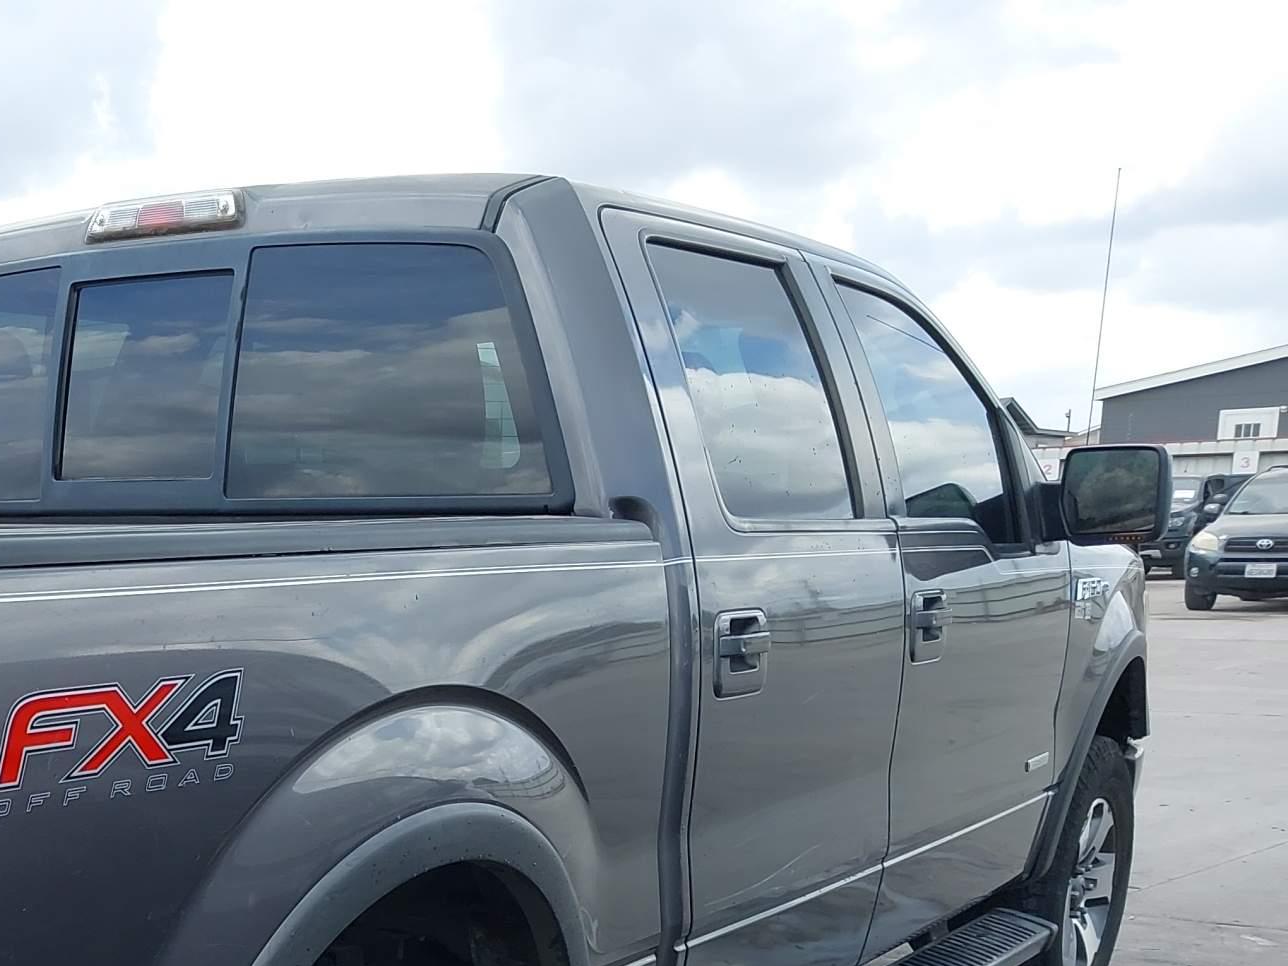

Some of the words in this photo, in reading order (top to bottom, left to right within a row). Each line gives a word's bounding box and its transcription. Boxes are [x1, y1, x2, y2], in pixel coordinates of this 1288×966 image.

[1240, 456, 1250, 468] 3
[1043, 464, 1052, 475] 2
[110, 763, 234, 799] ROAD
